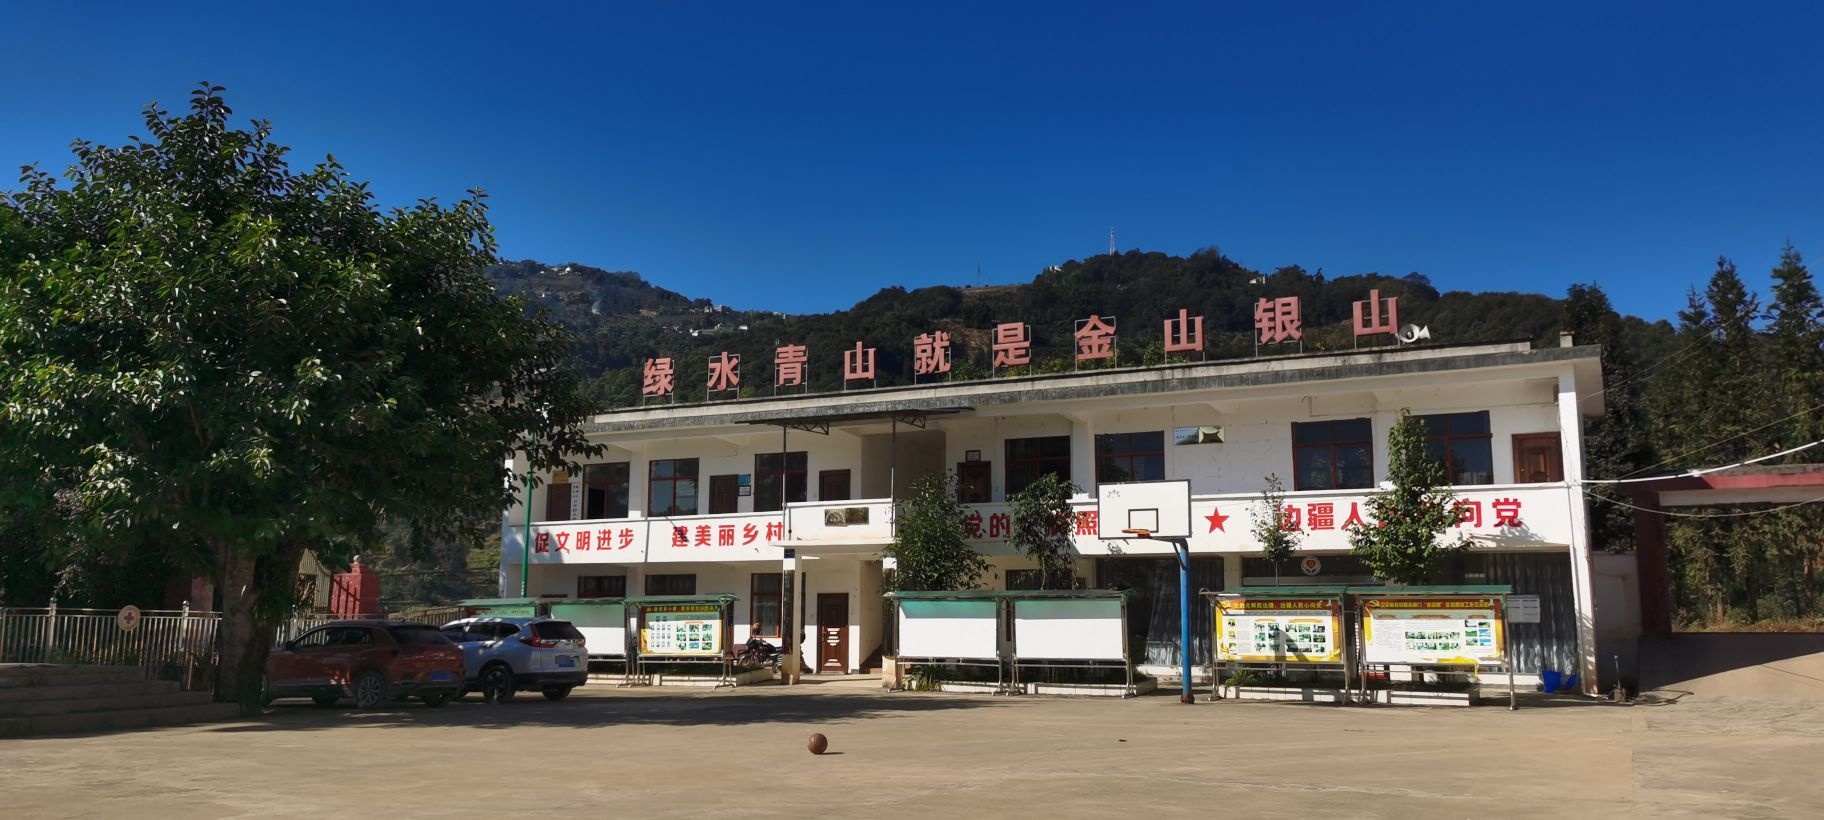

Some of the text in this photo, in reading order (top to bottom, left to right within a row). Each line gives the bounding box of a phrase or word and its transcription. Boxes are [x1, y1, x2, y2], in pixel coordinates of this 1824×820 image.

[643, 289, 1399, 396] 绿水青山就是金山银山
[534, 522, 784, 554] 促文明进步 建美丽乡村
[963, 497, 1523, 540] 党的照 边疆人向党
